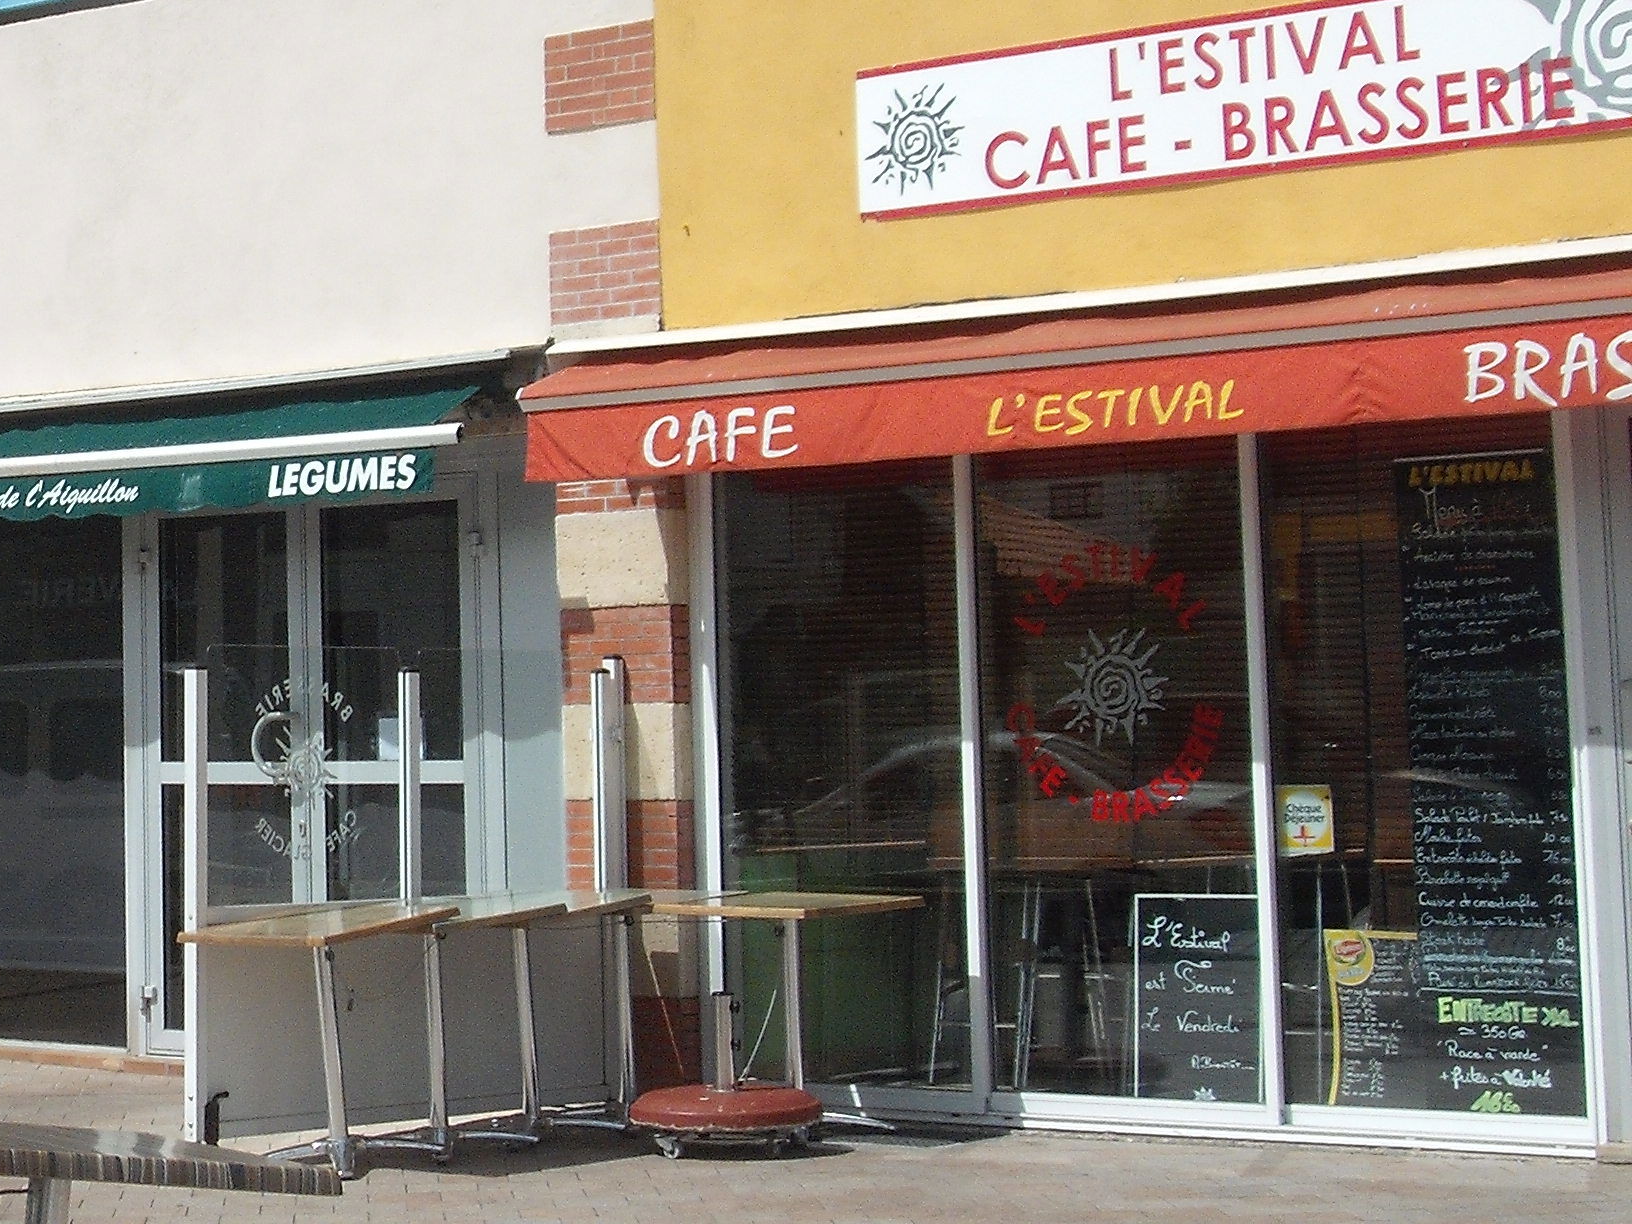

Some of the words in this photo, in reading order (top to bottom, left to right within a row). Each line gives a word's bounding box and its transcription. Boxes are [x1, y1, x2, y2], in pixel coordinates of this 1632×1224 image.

[1109, 5, 1421, 102] L'ESTIVAL
[985, 114, 1147, 190] CAFE
[1174, 138, 1192, 153] -
[1222, 56, 1576, 161] BRASSERIE
[987, 379, 1245, 437] L'ESTIVAL
[642, 405, 799, 468] CAFE
[24, 478, 139, 514] l'Aiguillon
[268, 454, 418, 498] LEGUMES
[1142, 916, 1231, 953] L'Estival
[1145, 971, 1166, 990] est
